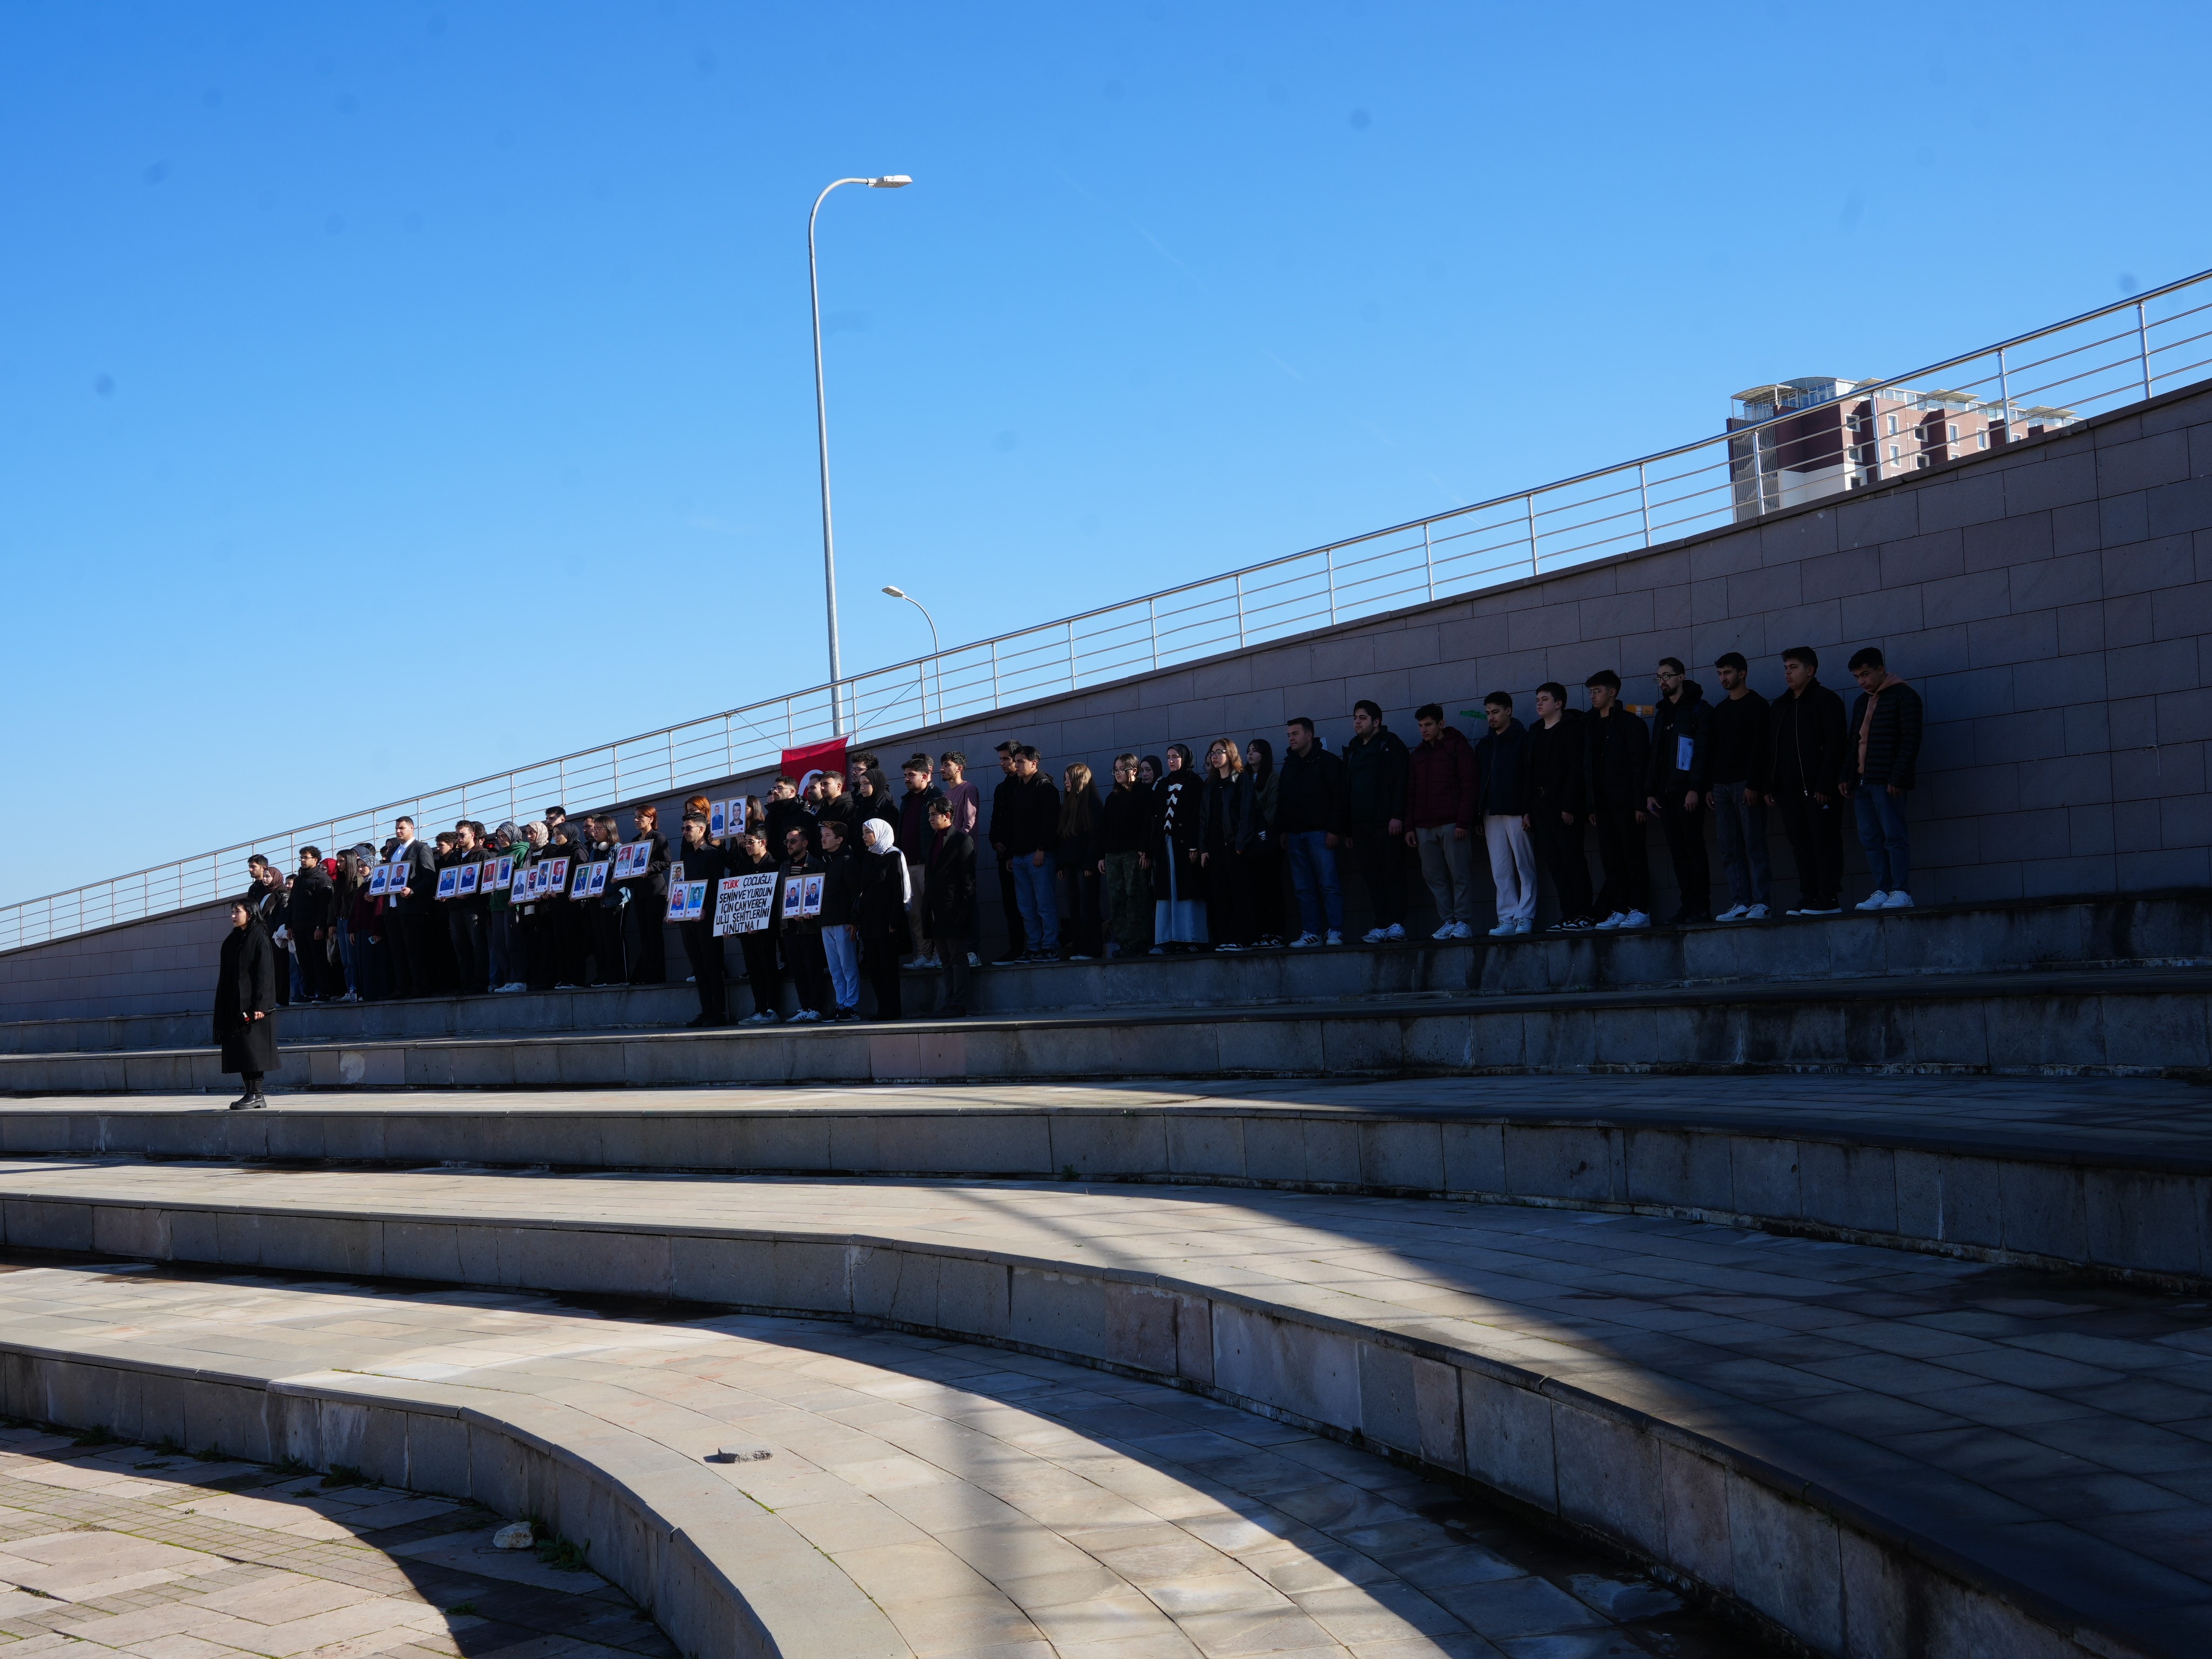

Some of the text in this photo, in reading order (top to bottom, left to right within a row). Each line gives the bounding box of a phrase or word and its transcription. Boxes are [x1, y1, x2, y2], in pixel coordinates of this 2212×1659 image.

[723, 879, 740, 890] TÜRK
[747, 887, 773, 899] YURDUN
[721, 898, 767, 915] İÇİN CAN VEREN
